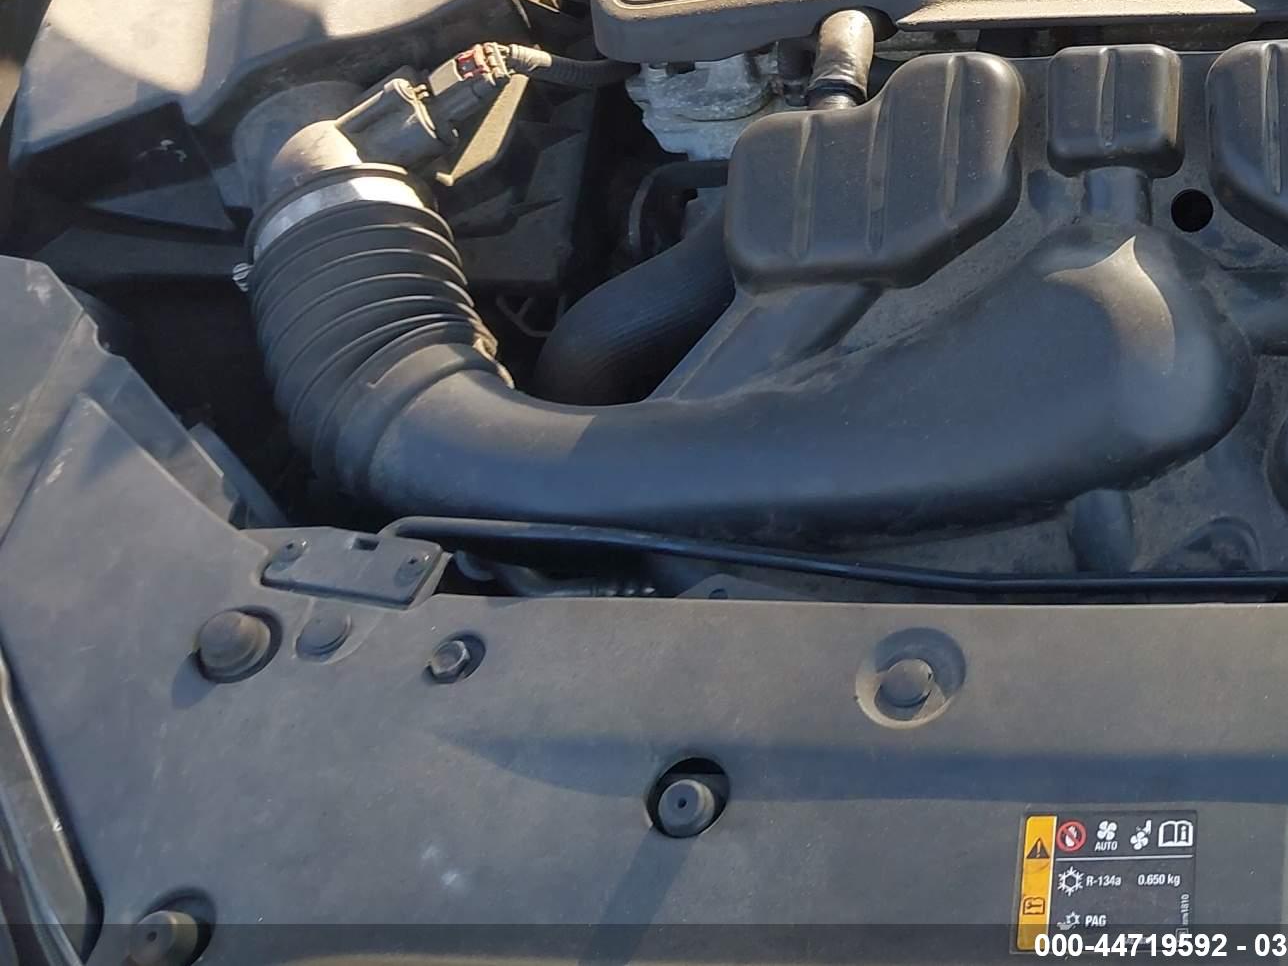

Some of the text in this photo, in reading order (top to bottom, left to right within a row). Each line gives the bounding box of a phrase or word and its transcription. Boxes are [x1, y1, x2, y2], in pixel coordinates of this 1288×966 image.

[1095, 841, 1118, 851] AUTO
[1086, 874, 1181, 887] R-134a 0.650 kg
[1084, 914, 1107, 927] PAG
